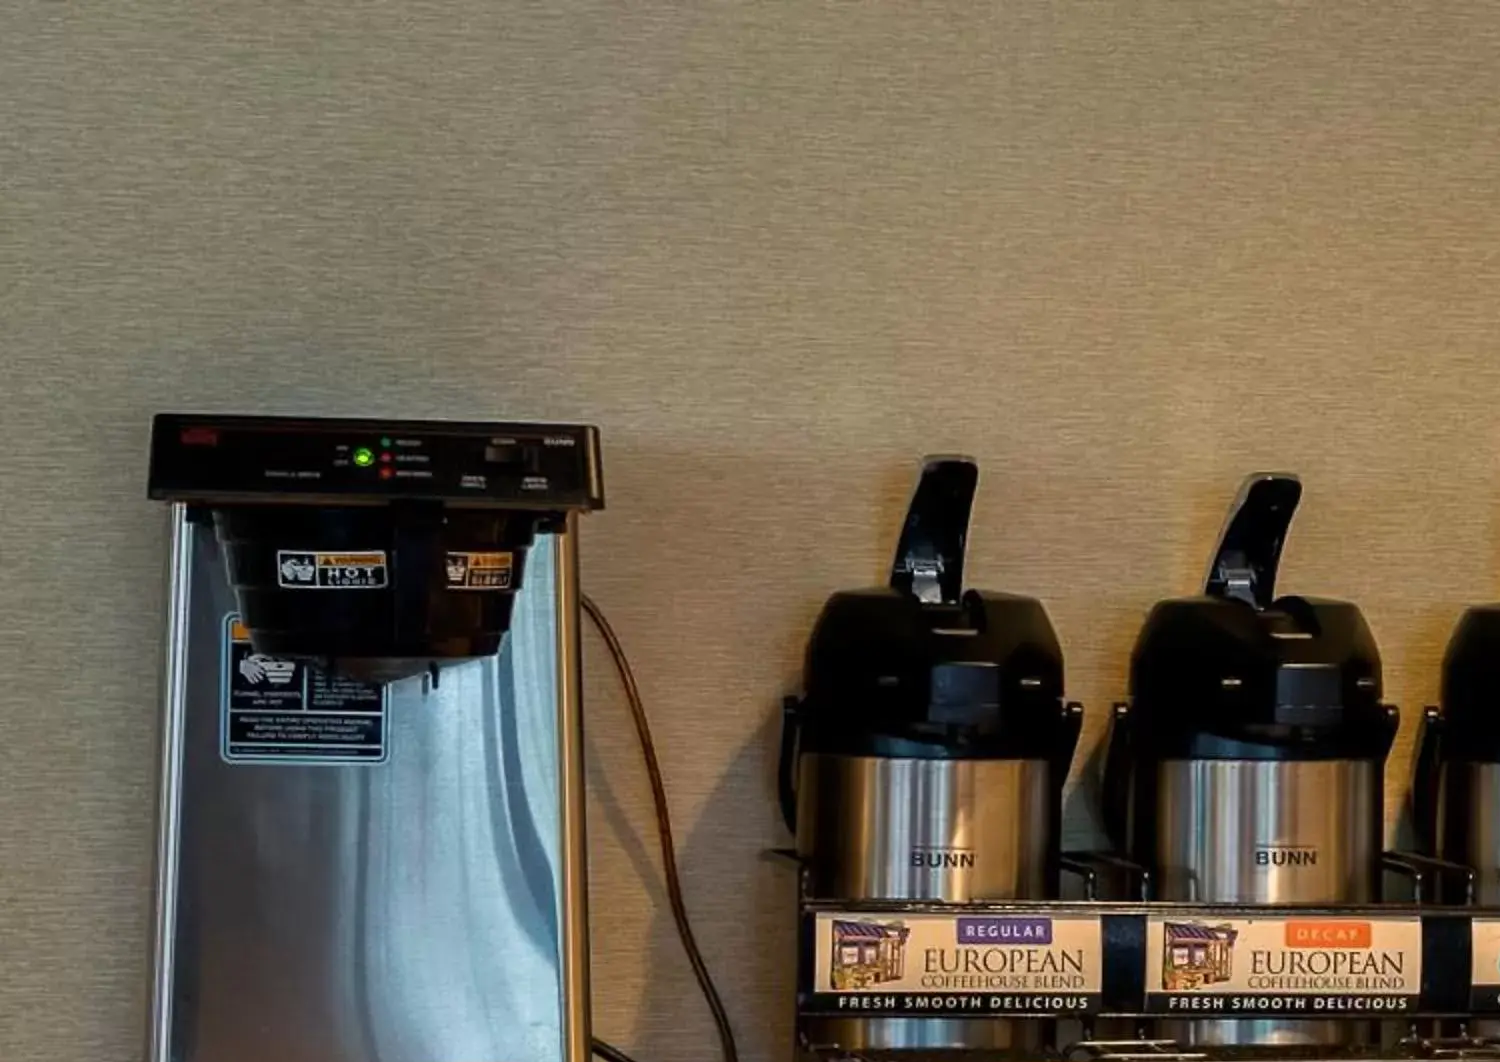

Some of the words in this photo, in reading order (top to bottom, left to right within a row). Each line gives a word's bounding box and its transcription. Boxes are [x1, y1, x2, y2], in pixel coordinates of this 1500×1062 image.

[911, 851, 975, 868] BUNN
[1255, 851, 1316, 866] BUNN
[965, 924, 1045, 937] REGULAR
[1296, 928, 1358, 941] DECAF
[924, 947, 1083, 974] EUROPEAN
[1251, 950, 1404, 975] EUROPEAN
[921, 975, 1029, 988] COFFEEHOUSE
[1034, 976, 1085, 988] BLEND
[1248, 976, 1351, 989] COFFEEHOUSE
[1356, 976, 1405, 989] BLEND
[839, 997, 895, 1009] FRESH
[904, 997, 981, 1009] SMOOTH
[990, 997, 1088, 1009] DELICIOUS
[1169, 997, 1223, 1009] FRESH
[1232, 997, 1305, 1009] SMOOTH
[1314, 997, 1407, 1009] DELICIOUS
